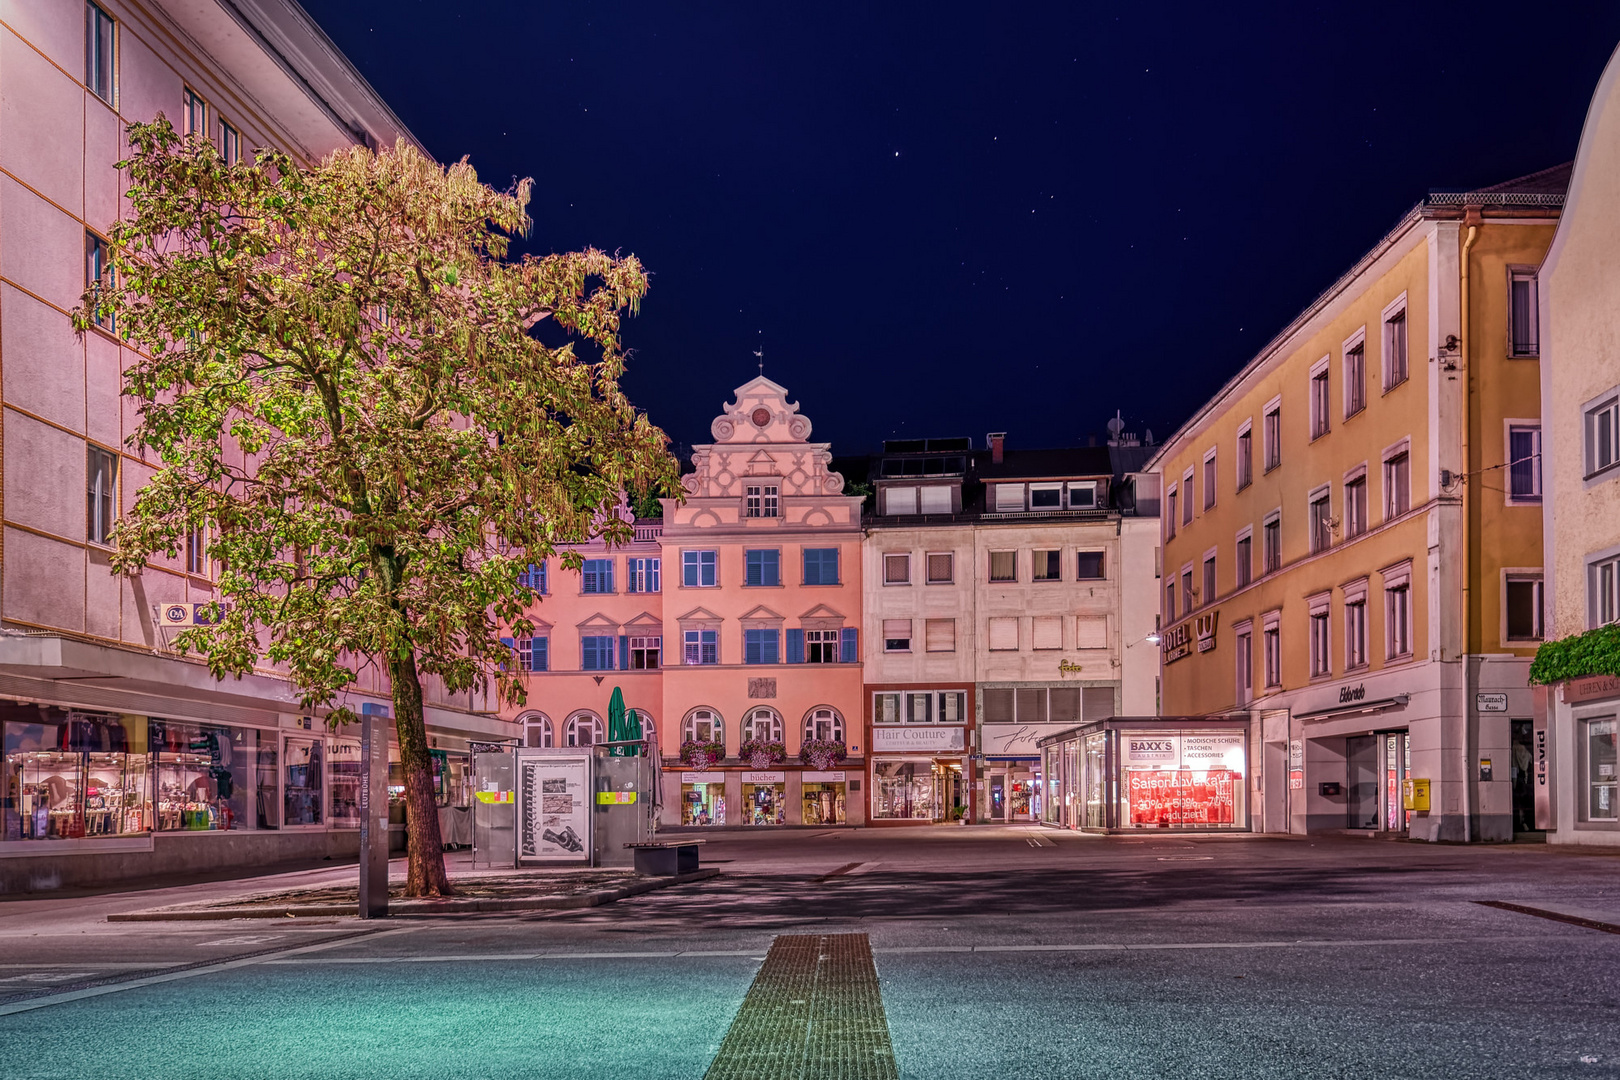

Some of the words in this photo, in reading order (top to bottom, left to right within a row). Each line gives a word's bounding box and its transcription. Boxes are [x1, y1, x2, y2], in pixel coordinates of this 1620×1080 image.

[169, 609, 184, 619] C&A
[1163, 625, 1187, 652] HOTEL
[1058, 659, 1082, 678] foto
[1339, 683, 1365, 703] Eldorado
[1579, 681, 1601, 695] UHREN
[1602, 680, 1608, 691] &
[876, 729, 900, 739] Hair
[903, 729, 946, 739] Couture
[1536, 730, 1546, 785] david
[750, 773, 776, 781] bücher
[522, 760, 541, 856] Brigantium
